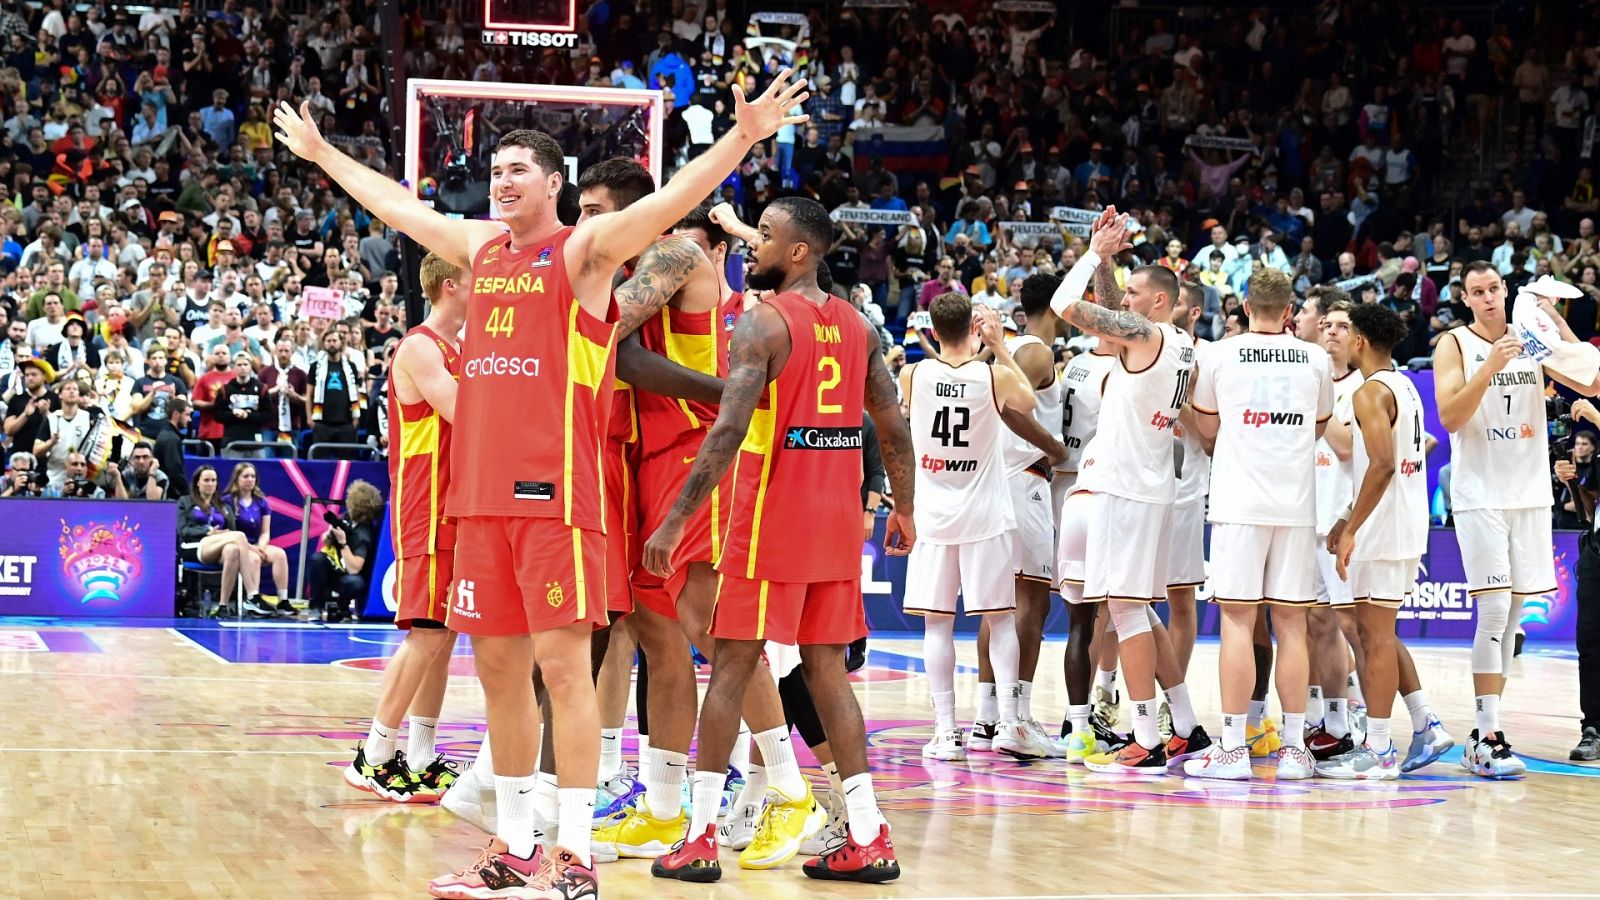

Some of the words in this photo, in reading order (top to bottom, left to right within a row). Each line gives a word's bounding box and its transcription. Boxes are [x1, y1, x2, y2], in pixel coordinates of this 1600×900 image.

[509, 31, 578, 48] TISSOT
[1009, 223, 1085, 236] DEUTSCHAND
[474, 272, 545, 294] ESPAÑA
[485, 306, 515, 338] 44
[465, 351, 540, 378] endesa
[1239, 348, 1309, 363] SENGFELDER
[817, 356, 843, 414] 2
[1170, 369, 1189, 409] 10
[1487, 371, 1537, 387] TSCHLAND
[936, 382, 967, 398] OBST
[1063, 387, 1076, 427] 5
[1503, 394, 1512, 416] 7
[931, 406, 970, 447] 42
[1151, 411, 1177, 431] tipw
[1243, 408, 1304, 428] tipwin
[75, 425, 83, 437] 5
[1486, 427, 1516, 441] ING
[921, 454, 978, 474] tipwin
[1400, 459, 1423, 477] tipw
[85, 554, 121, 568] 2022
[1487, 575, 1508, 584] ING
[1401, 581, 1473, 609] ASKET
